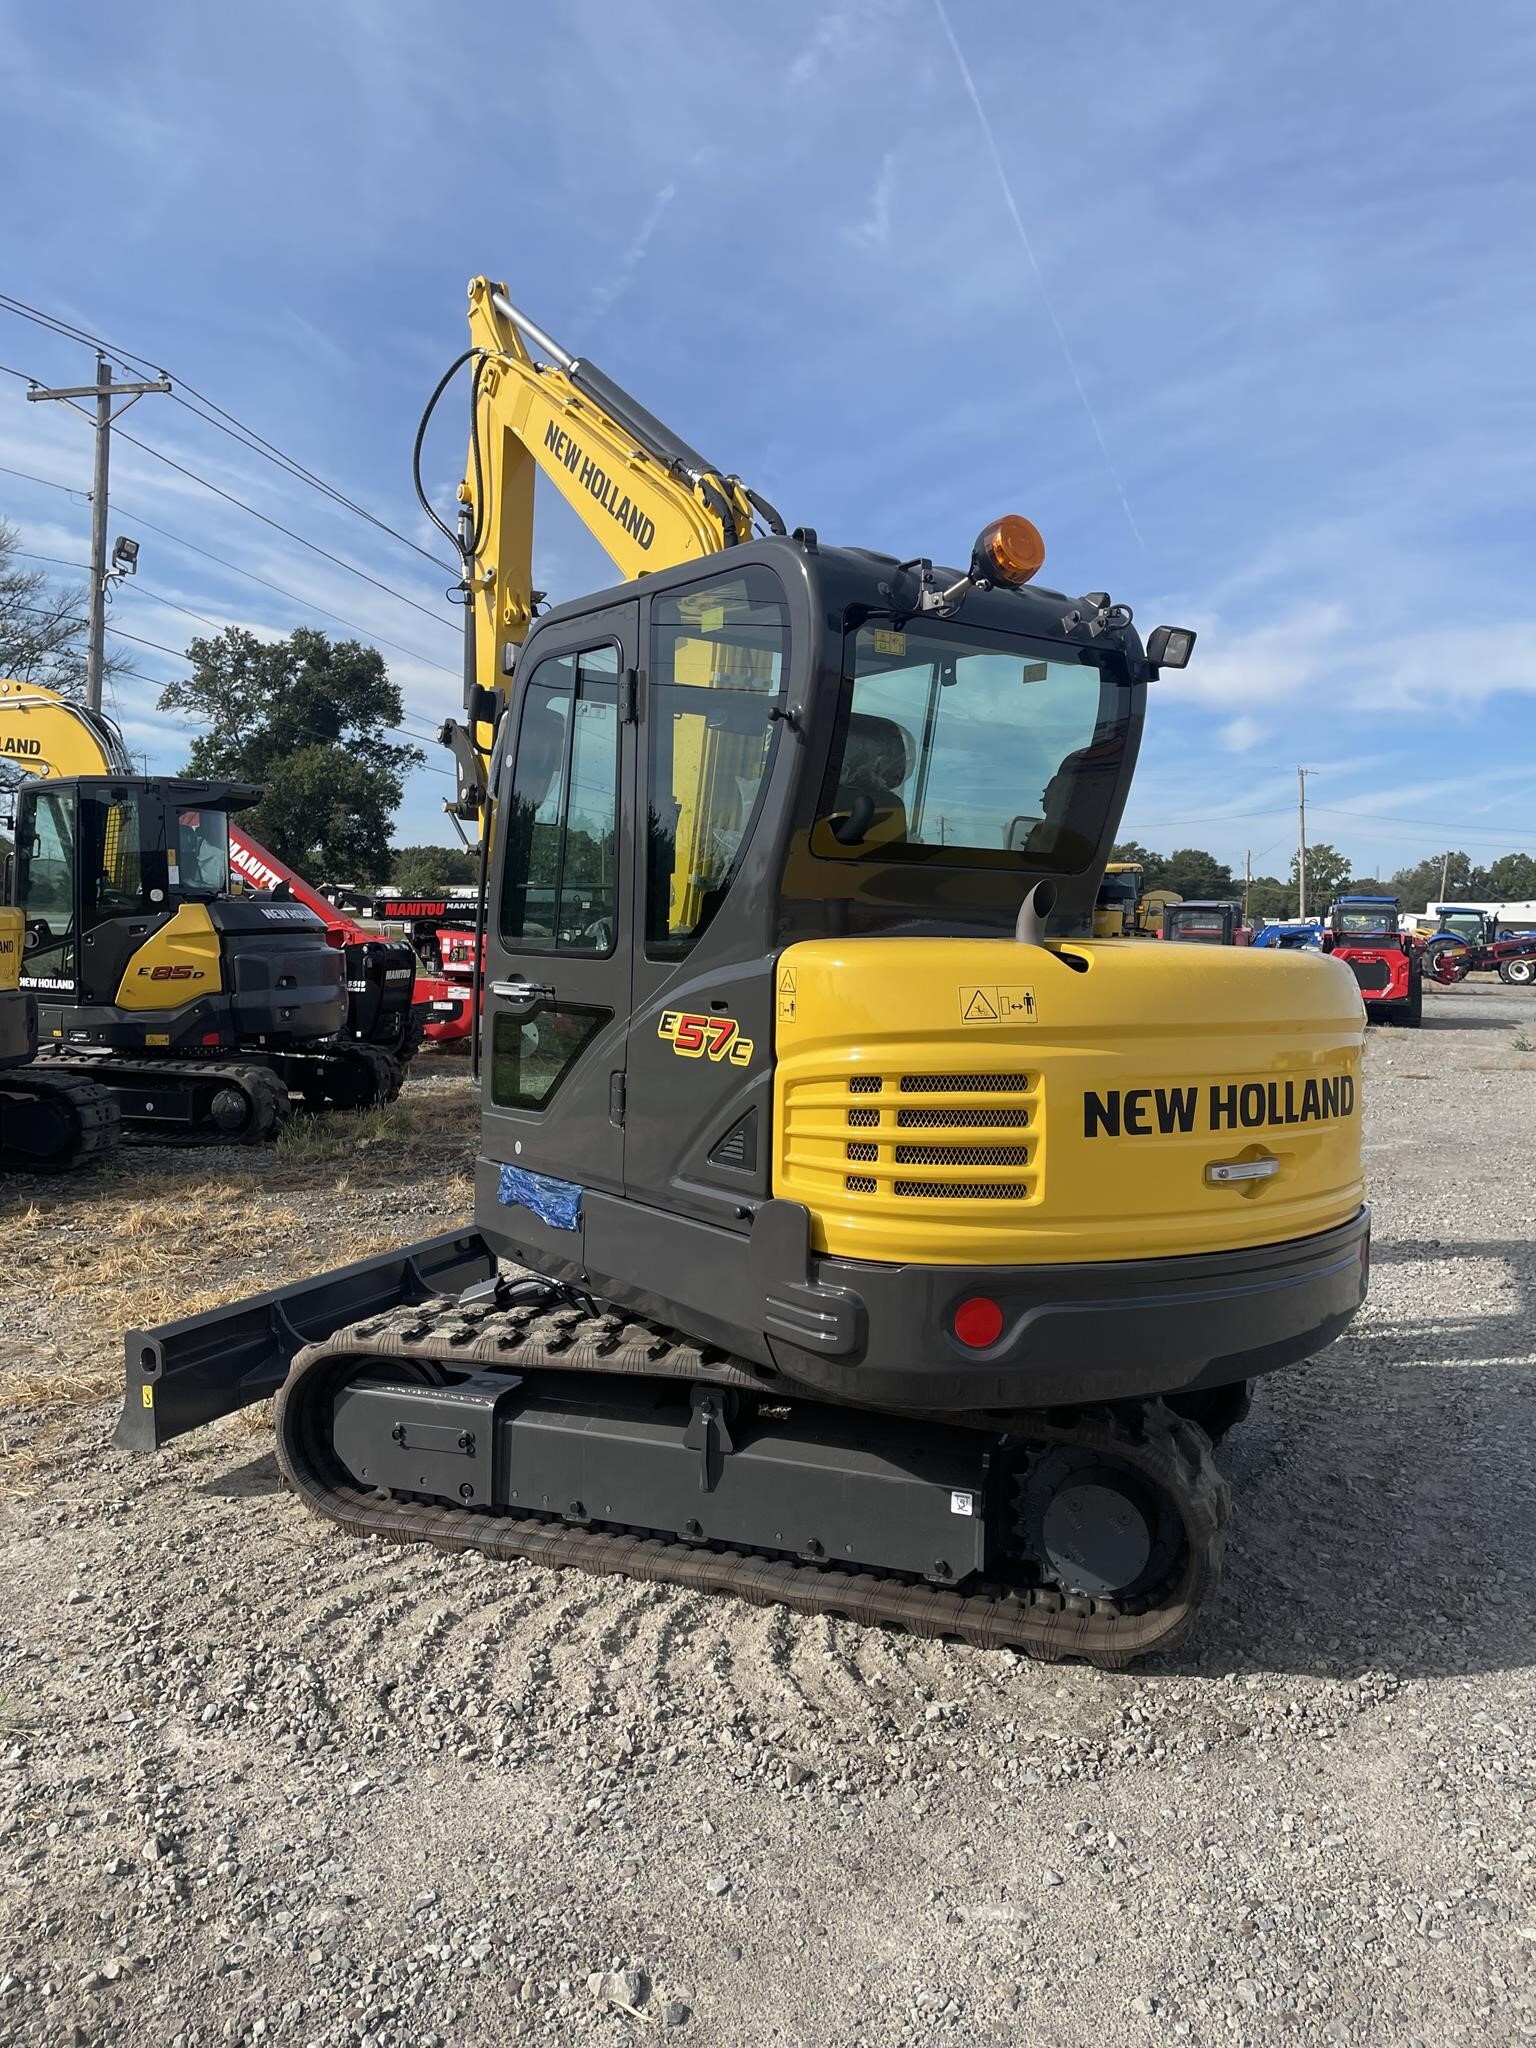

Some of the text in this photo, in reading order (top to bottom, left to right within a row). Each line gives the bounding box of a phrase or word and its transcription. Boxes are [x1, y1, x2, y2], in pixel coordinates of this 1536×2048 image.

[544, 419, 655, 551] NEW HOLLAND
[384, 903, 446, 916] MANITOU
[385, 969, 411, 979] MANITOU
[38, 977, 75, 990] HOLLAND
[1084, 1075, 1354, 1138] NEW HOLLAND
